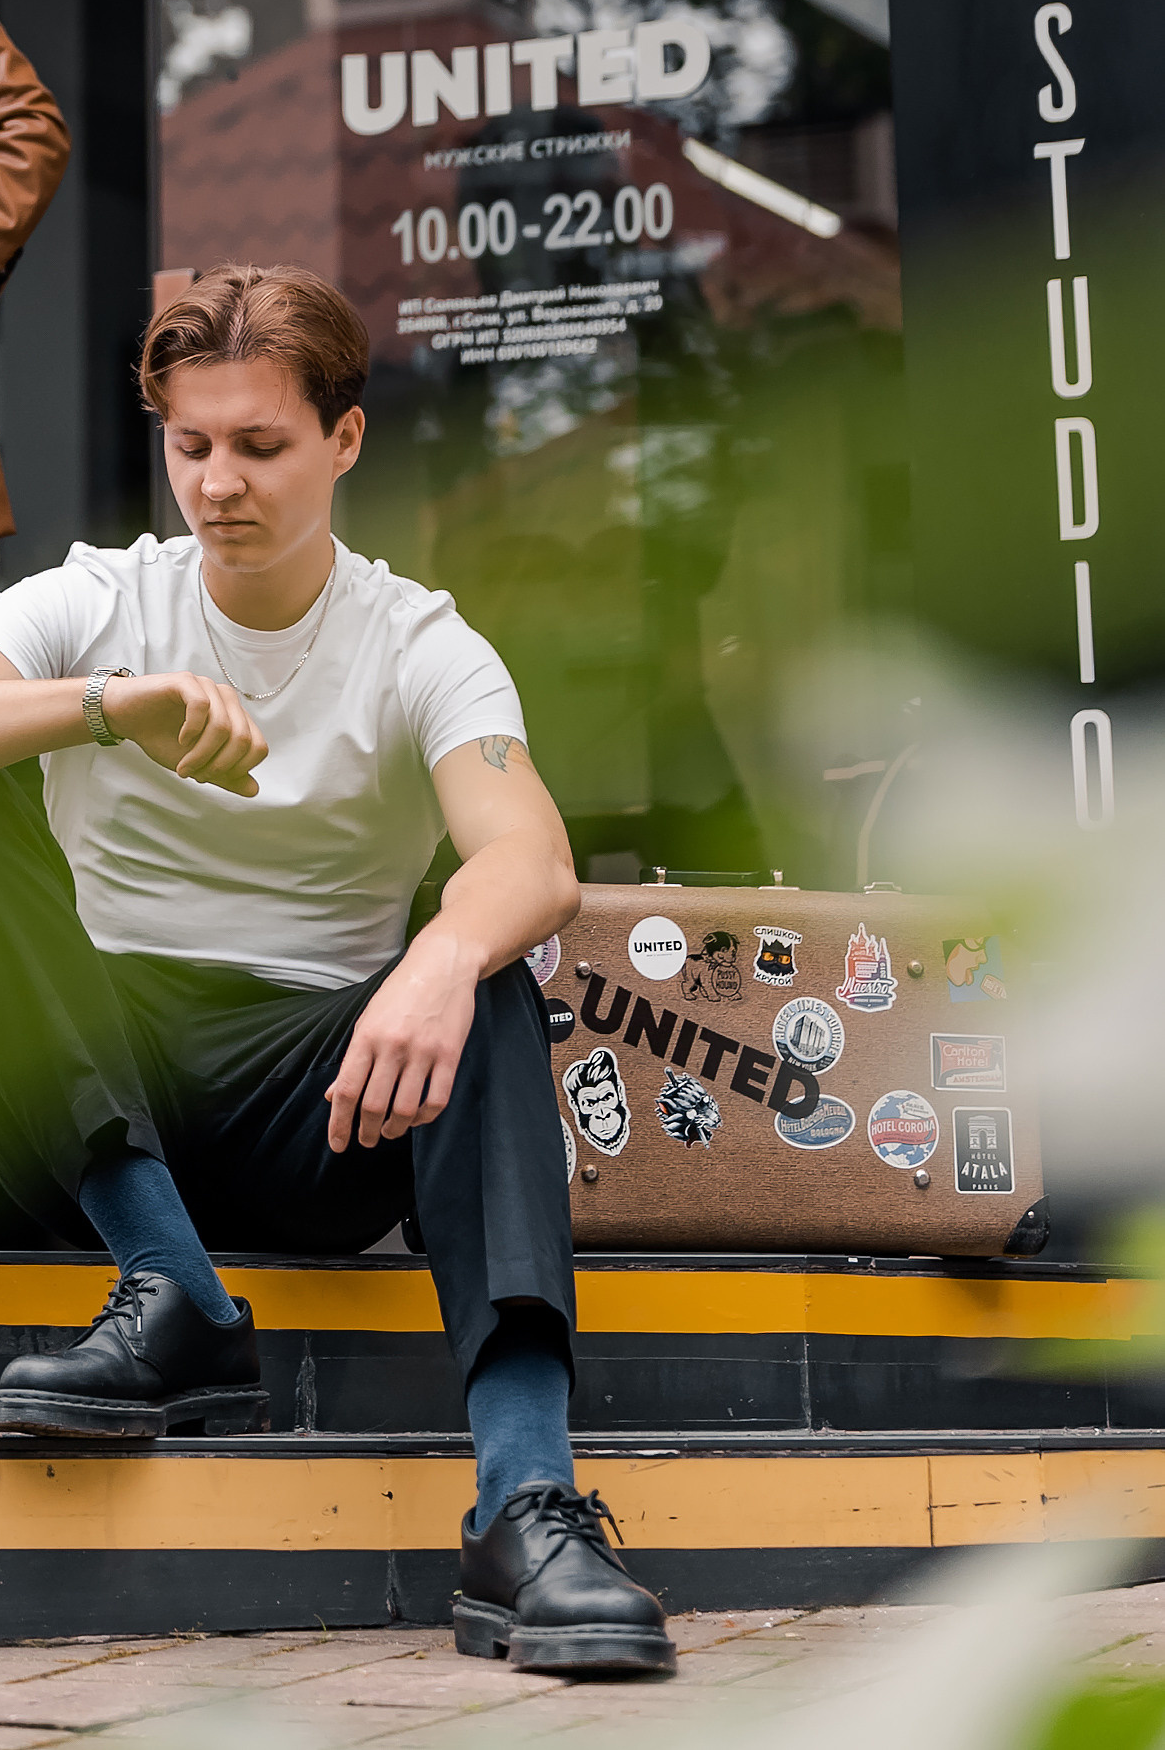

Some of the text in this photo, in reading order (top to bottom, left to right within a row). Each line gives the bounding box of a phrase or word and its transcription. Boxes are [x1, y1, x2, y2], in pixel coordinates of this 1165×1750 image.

[341, 19, 711, 136] UNITED
[424, 129, 632, 171] МУЖСКИЕ СТРИЖКИ
[391, 182, 674, 265] 10.00-22.00
[1033, 2, 1115, 834] STUDIO
[755, 927, 802, 942] СЛИШКОМ
[634, 940, 683, 953] UNITED
[755, 971, 792, 986] КРУТОЙ
[839, 976, 894, 996] Maestro
[549, 1011, 574, 1024] ITED
[775, 999, 842, 1056] HOTEL TIMES SQUARE
[580, 972, 820, 1119] UNITED
[942, 1045, 985, 1058] Carlton
[957, 1057, 989, 1067] Hotel
[871, 1119, 936, 1136] HOTEL CORONA
[961, 1161, 1008, 1180] ATALA
